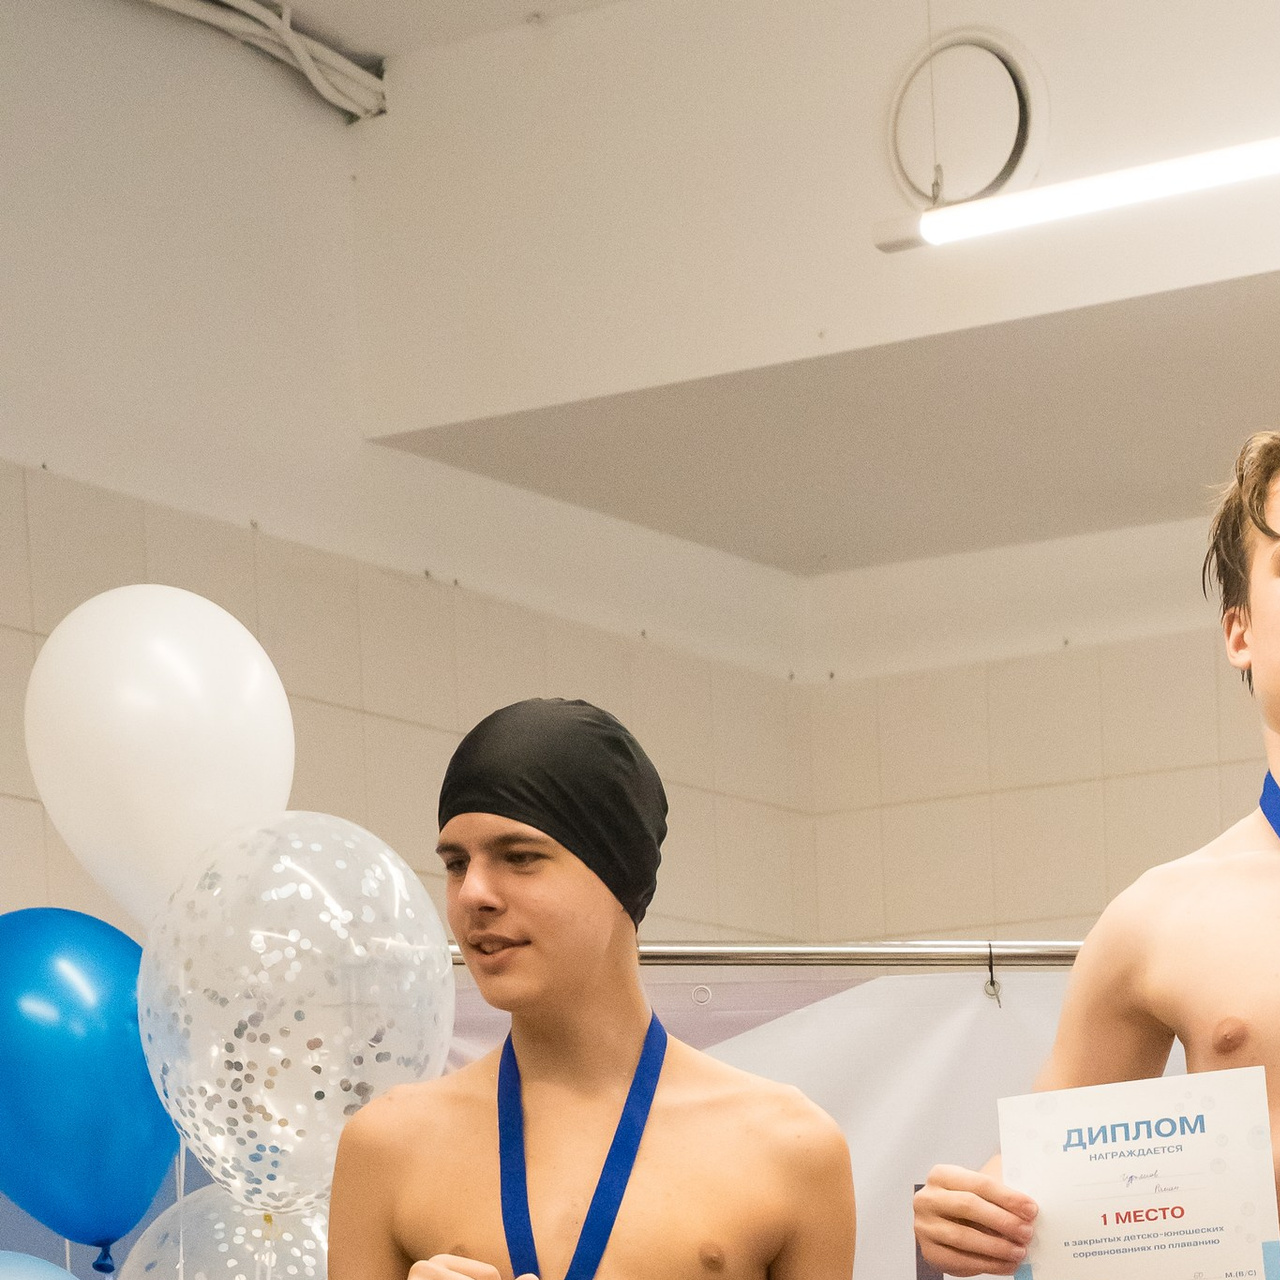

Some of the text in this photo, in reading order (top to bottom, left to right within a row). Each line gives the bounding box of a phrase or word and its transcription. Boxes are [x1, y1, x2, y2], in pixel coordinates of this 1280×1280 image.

[1063, 1115, 1206, 1151] ДИПЛОМ
[1090, 1145, 1183, 1161] НАГРАЖДАЕТСЯ
[1101, 1206, 1185, 1226] 1 МЕСТО
[1072, 1235, 1122, 1247] закрытых
[1123, 1226, 1224, 1243] детско-юношеских
[1073, 1238, 1220, 1259] соревнованиях по плаванию
